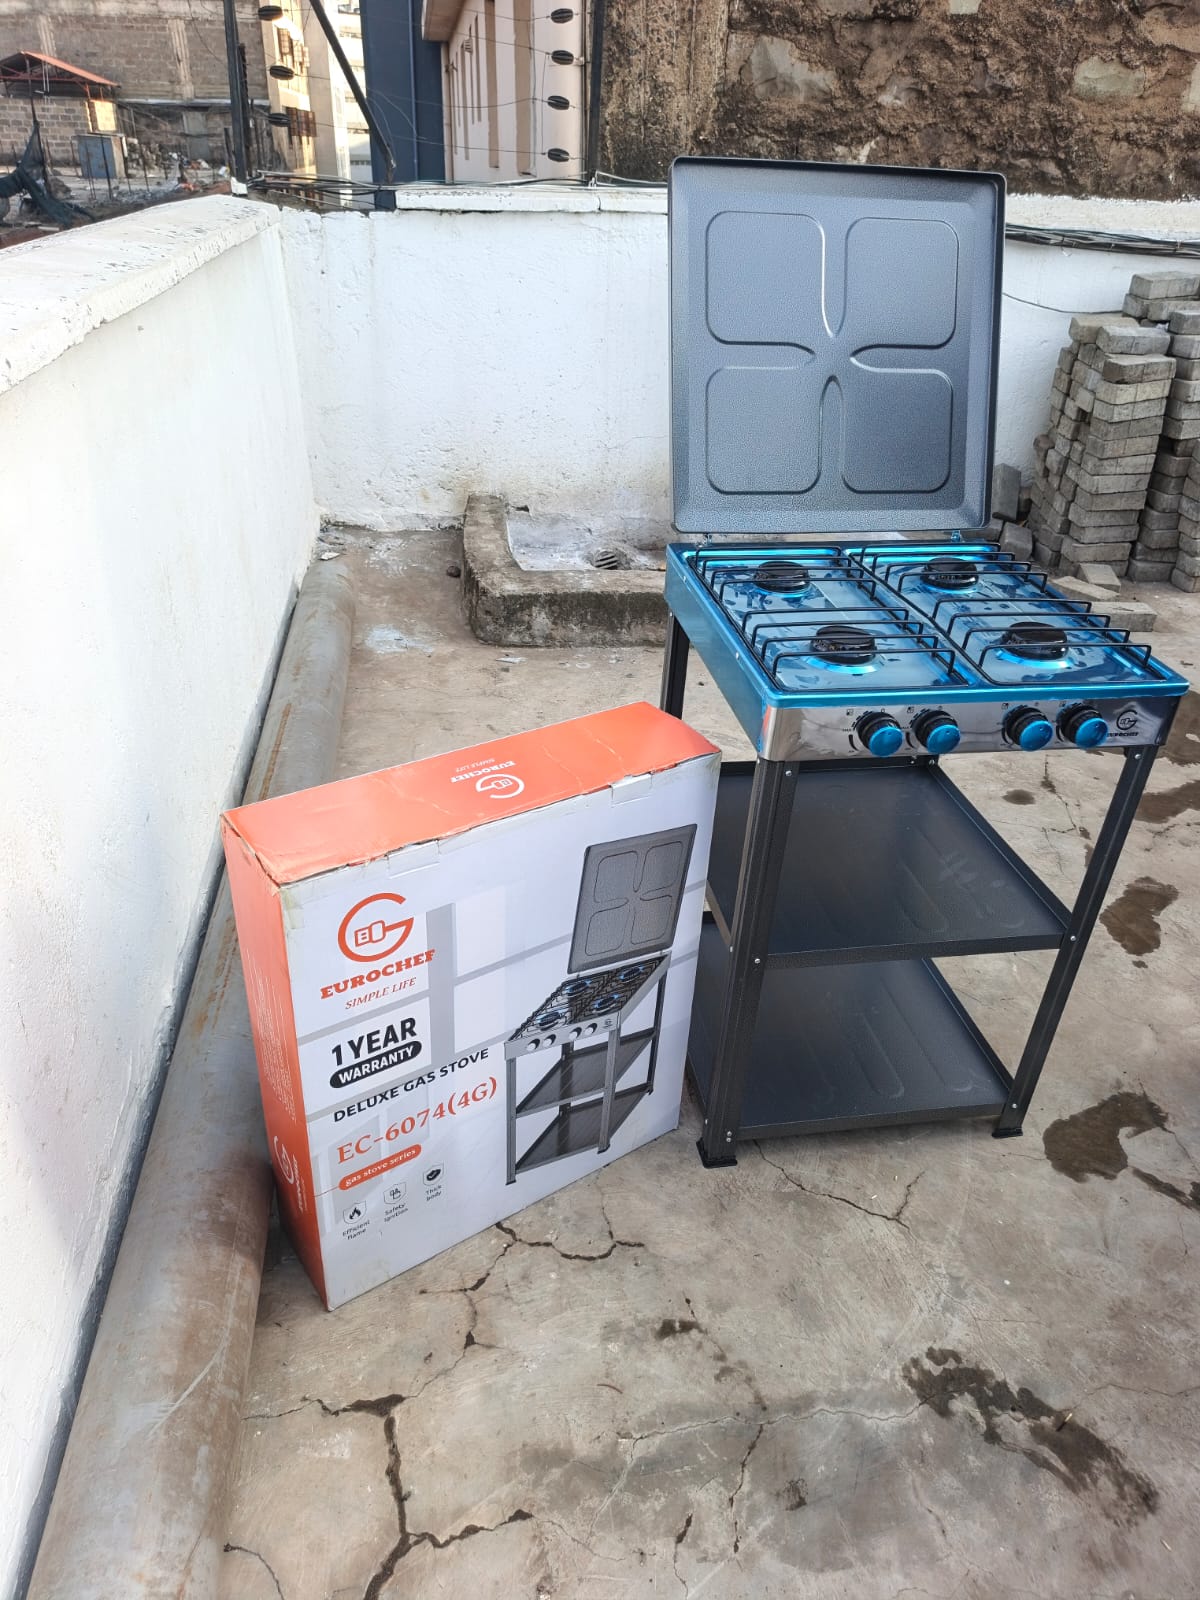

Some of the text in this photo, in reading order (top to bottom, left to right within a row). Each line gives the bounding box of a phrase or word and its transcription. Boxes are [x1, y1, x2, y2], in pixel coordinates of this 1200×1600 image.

[320, 948, 436, 1000] EUROCHEF
[345, 976, 417, 1010] SIMPLE LIFE
[331, 1017, 417, 1066] 1 YEAR
[338, 1046, 415, 1085] WARRANTY
[333, 1048, 489, 1123] DELUXE GAS STOVE
[337, 1076, 498, 1164] EC-6074(4G)
[345, 1148, 417, 1188] gas stove series
